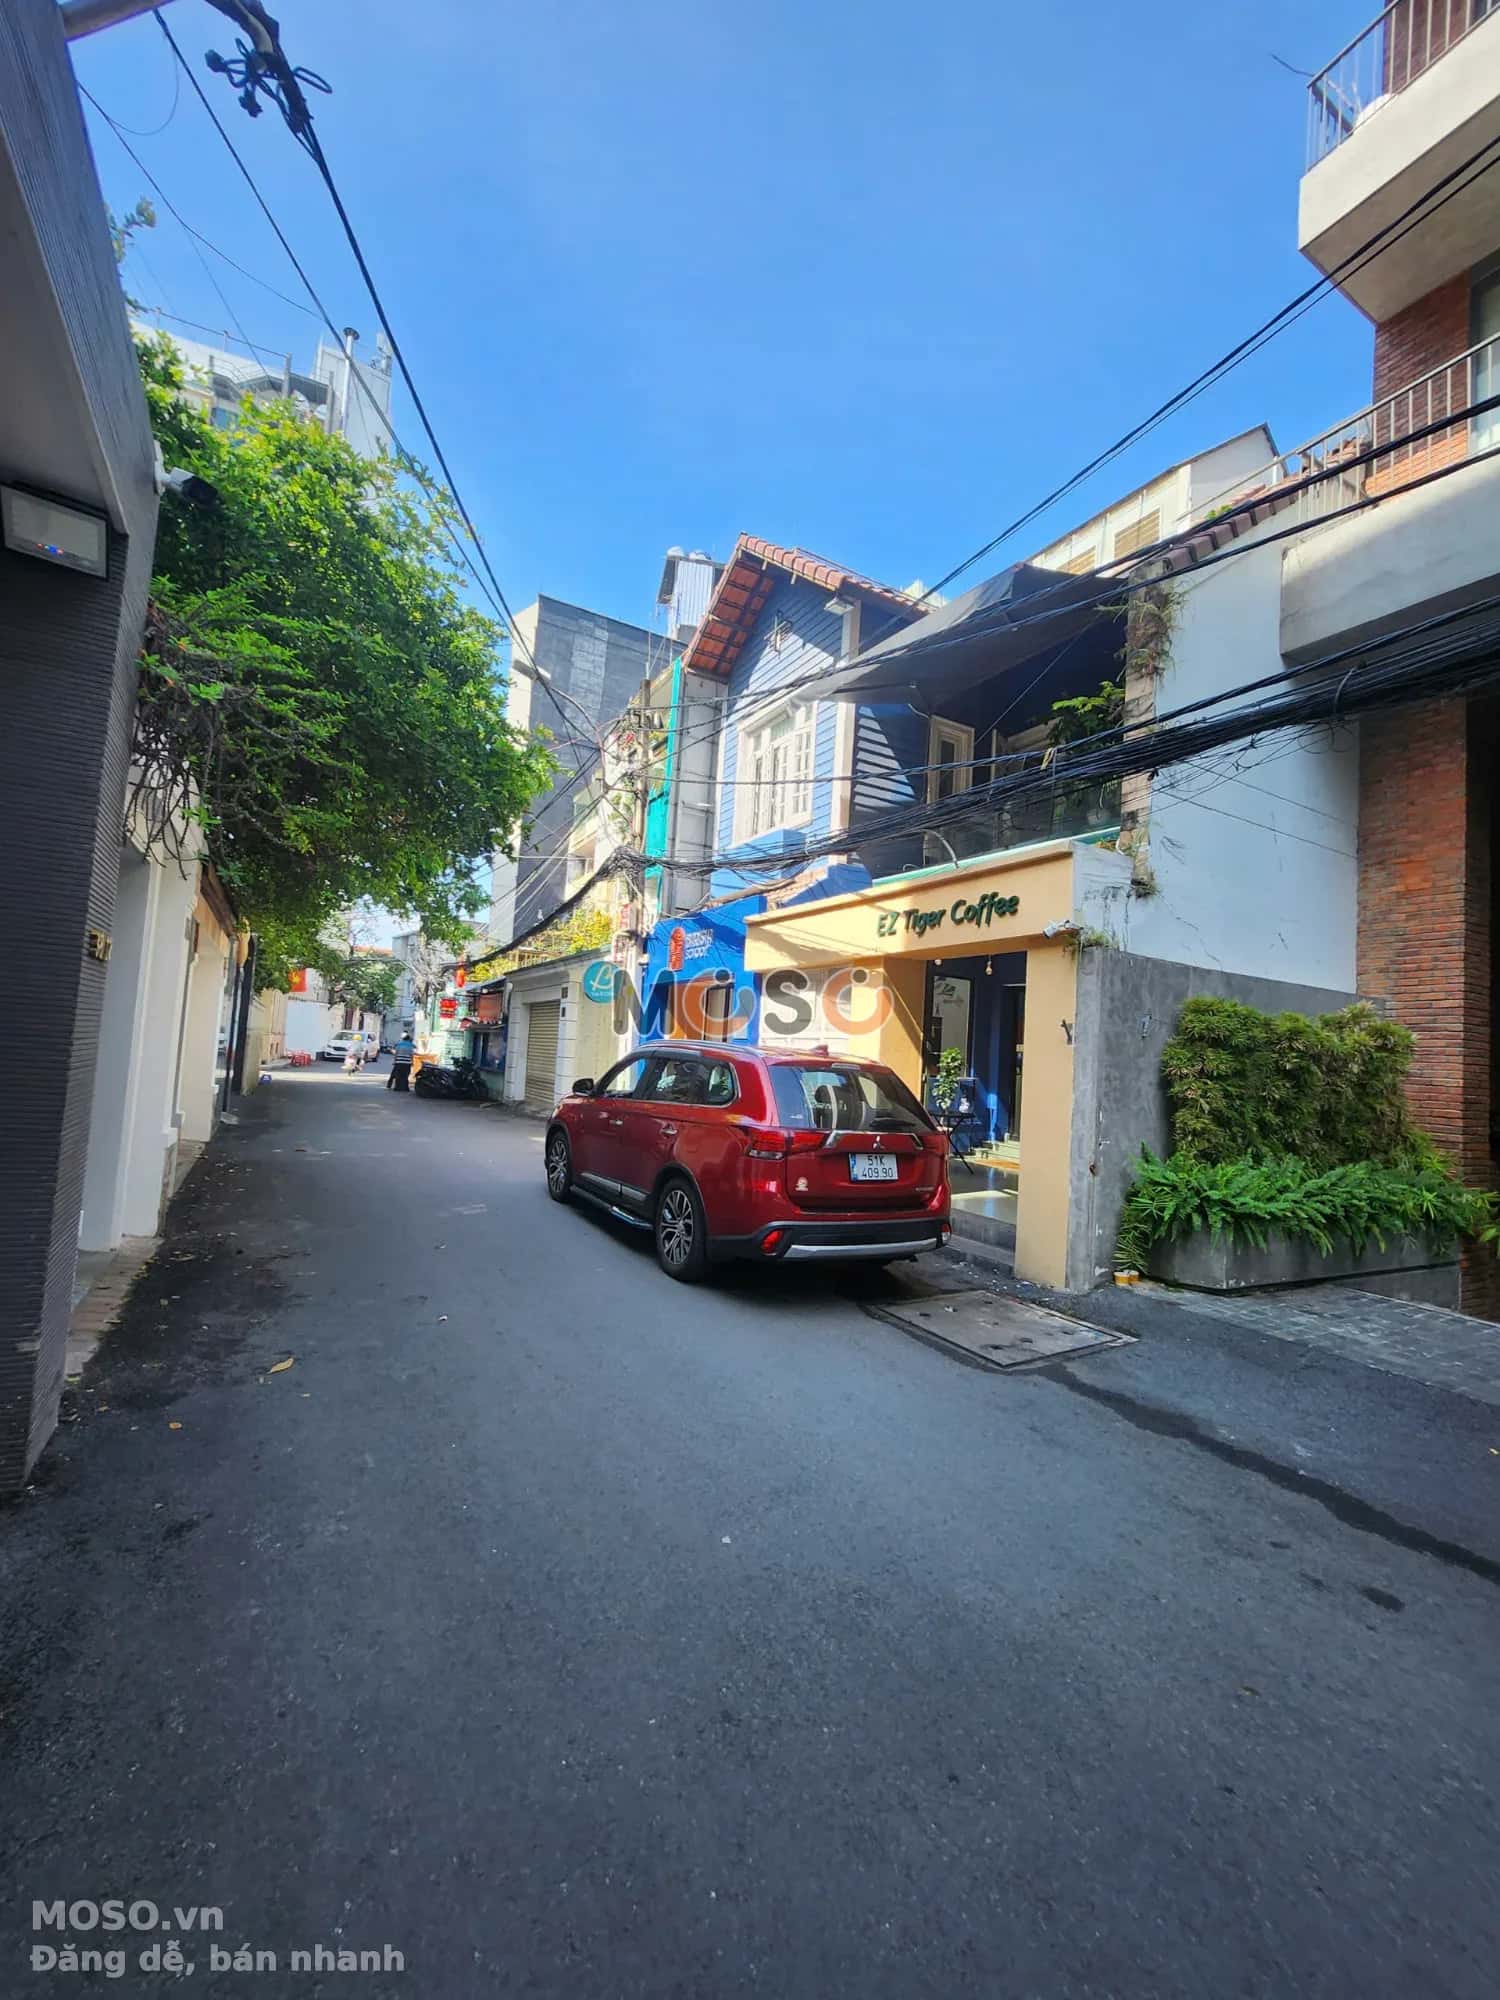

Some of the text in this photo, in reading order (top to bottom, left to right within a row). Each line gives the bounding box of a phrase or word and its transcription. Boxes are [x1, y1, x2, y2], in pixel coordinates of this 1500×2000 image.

[877, 891, 1020, 938] EZ Tiger Coffee
[867, 1154, 885, 1166] 51K
